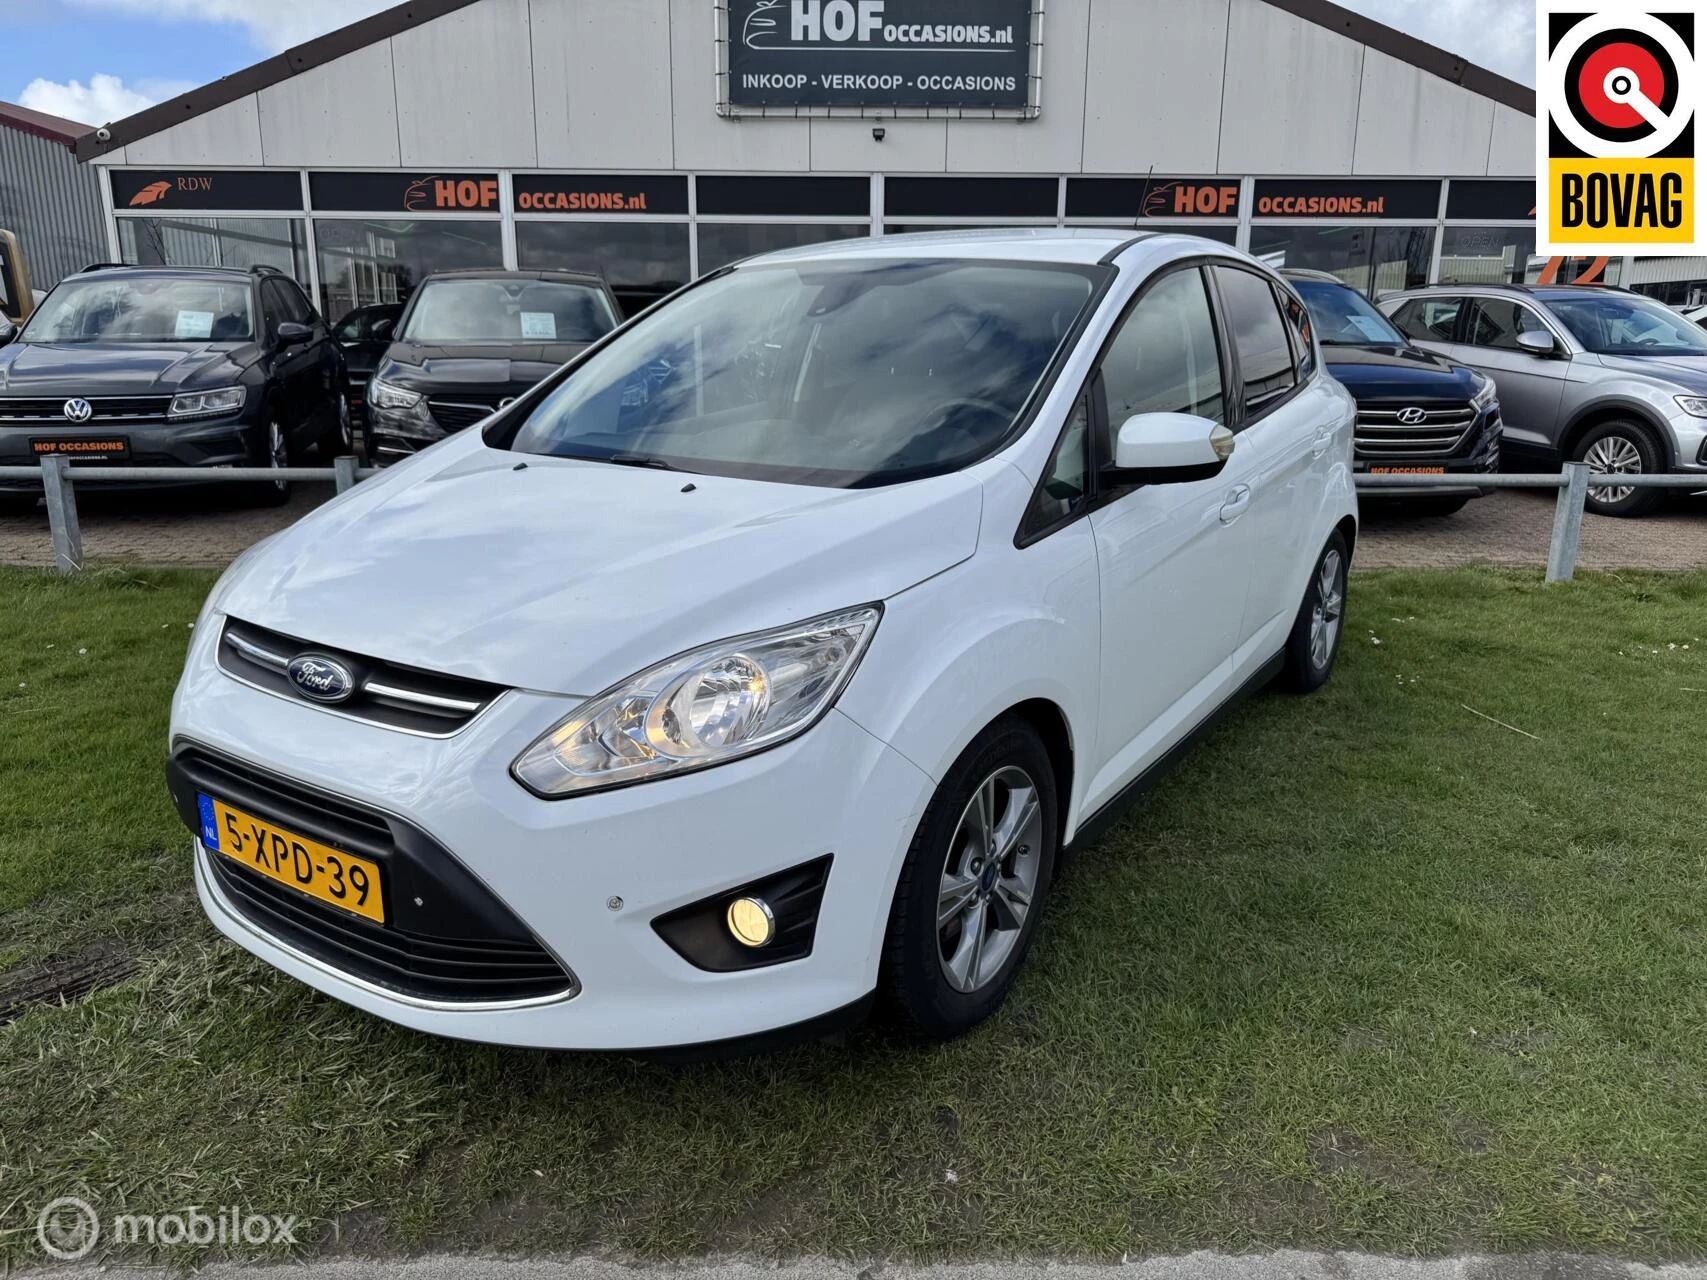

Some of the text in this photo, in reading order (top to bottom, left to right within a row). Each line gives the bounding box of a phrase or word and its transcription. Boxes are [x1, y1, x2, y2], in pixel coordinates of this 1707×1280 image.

[790, 0, 1014, 44] HOF OCCASIONS.nl
[742, 73, 808, 90] INKOOP
[821, 74, 903, 90] VERKOOP
[917, 75, 1016, 91] OCCASIONS
[177, 176, 213, 192] RDW
[434, 179, 647, 210] HOF OCCASIONS.nl
[1174, 185, 1385, 214] HOF OCCASIONS.nl
[34, 442, 124, 452] HOF OCCASIONS
[297, 661, 334, 692] Ford
[204, 825, 218, 842] NL
[224, 812, 370, 907] 5-XPD-39
